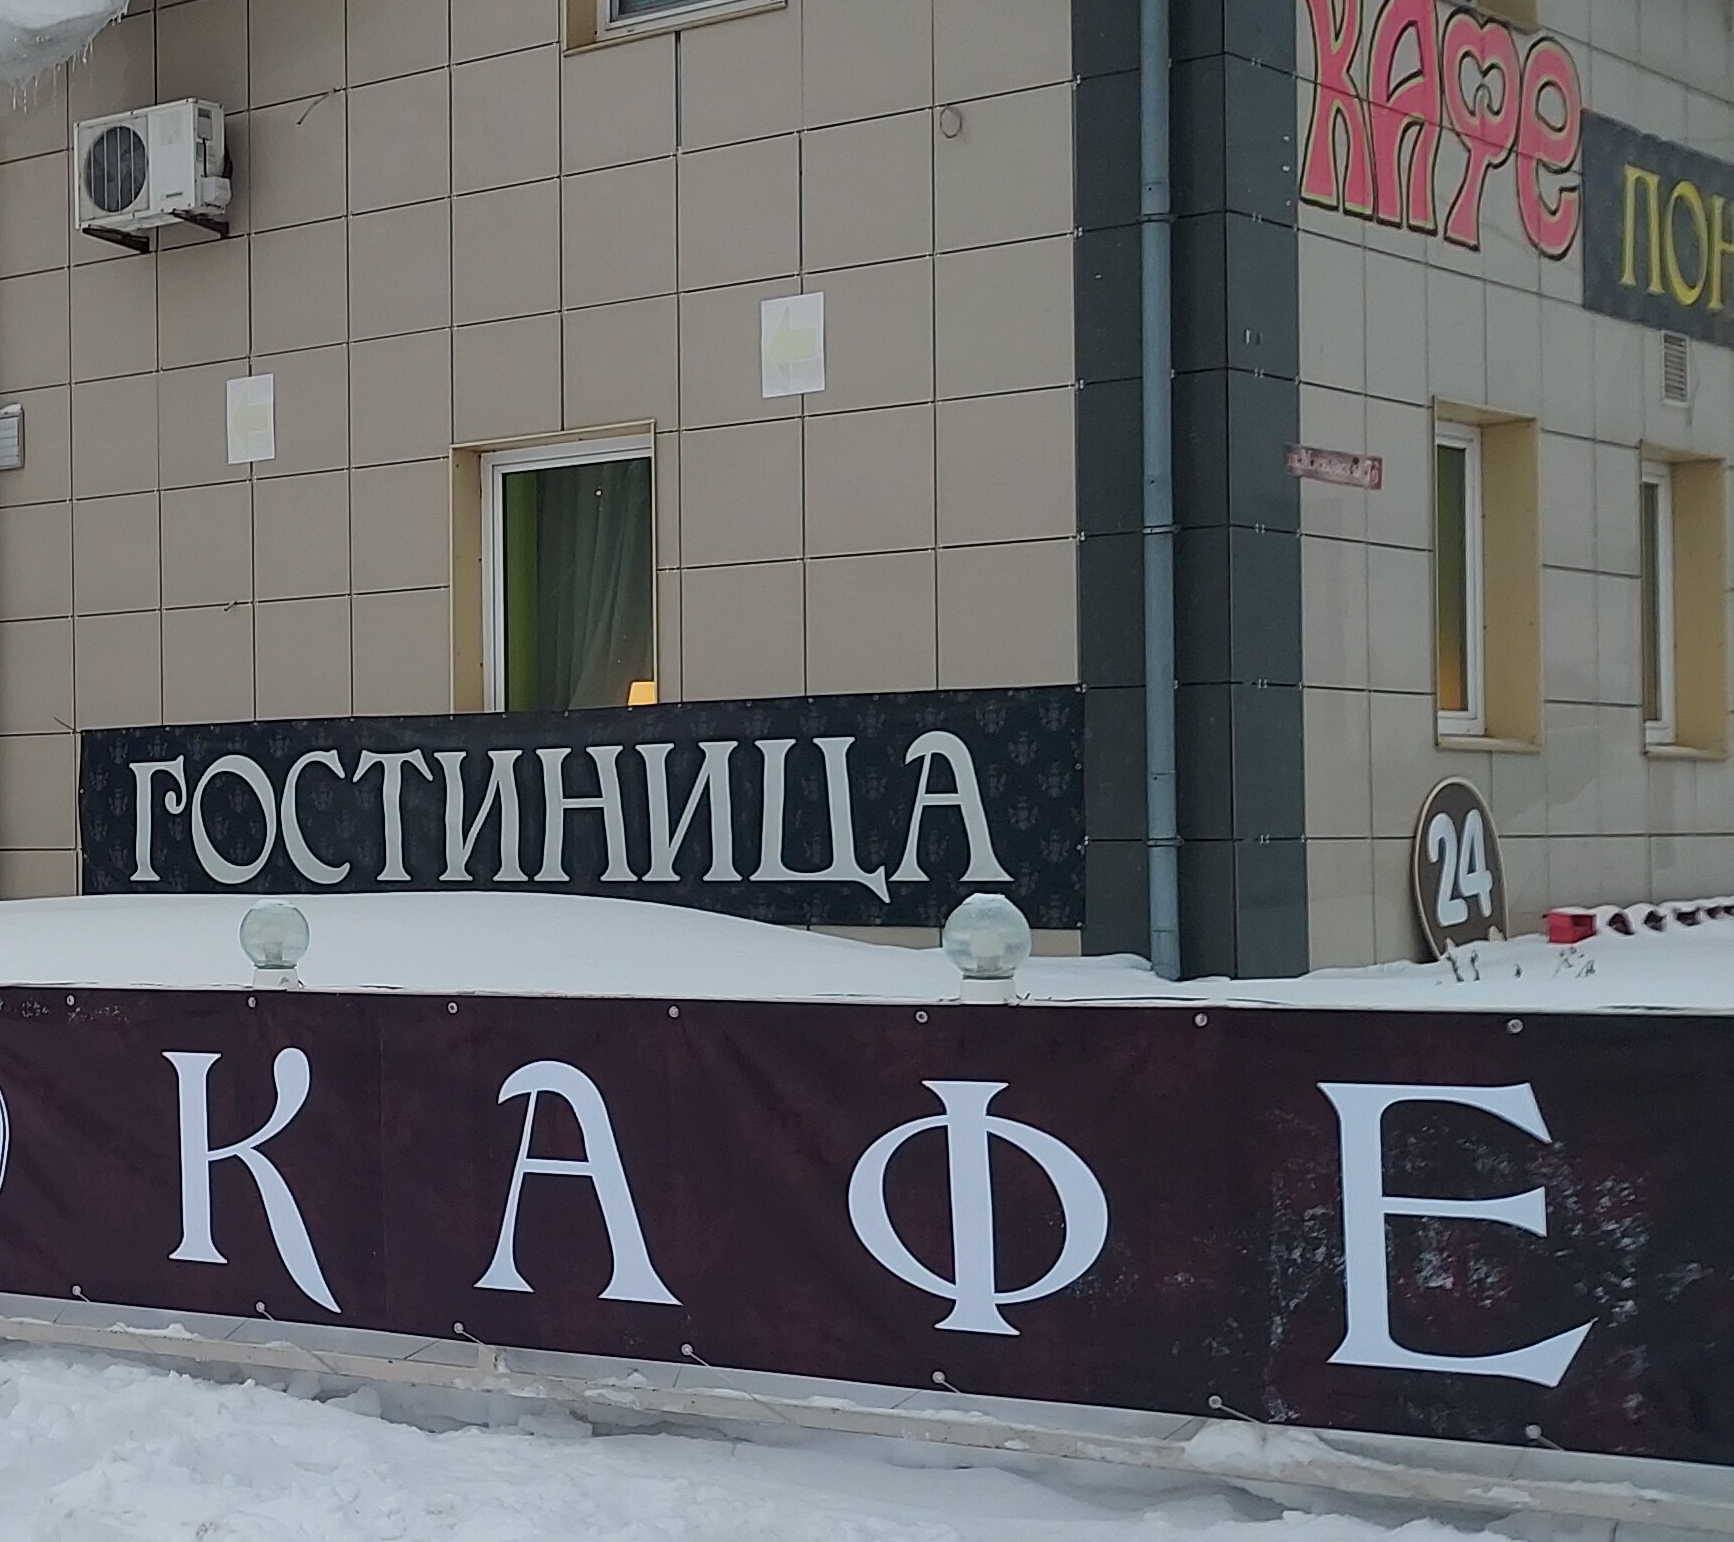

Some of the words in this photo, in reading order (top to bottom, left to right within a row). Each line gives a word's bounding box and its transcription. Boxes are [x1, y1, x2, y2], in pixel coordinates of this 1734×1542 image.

[128, 730, 1016, 904] ГОСТИНИЦА
[1427, 808, 1494, 929] 24
[162, 1045, 1599, 1389] КАФЕ
